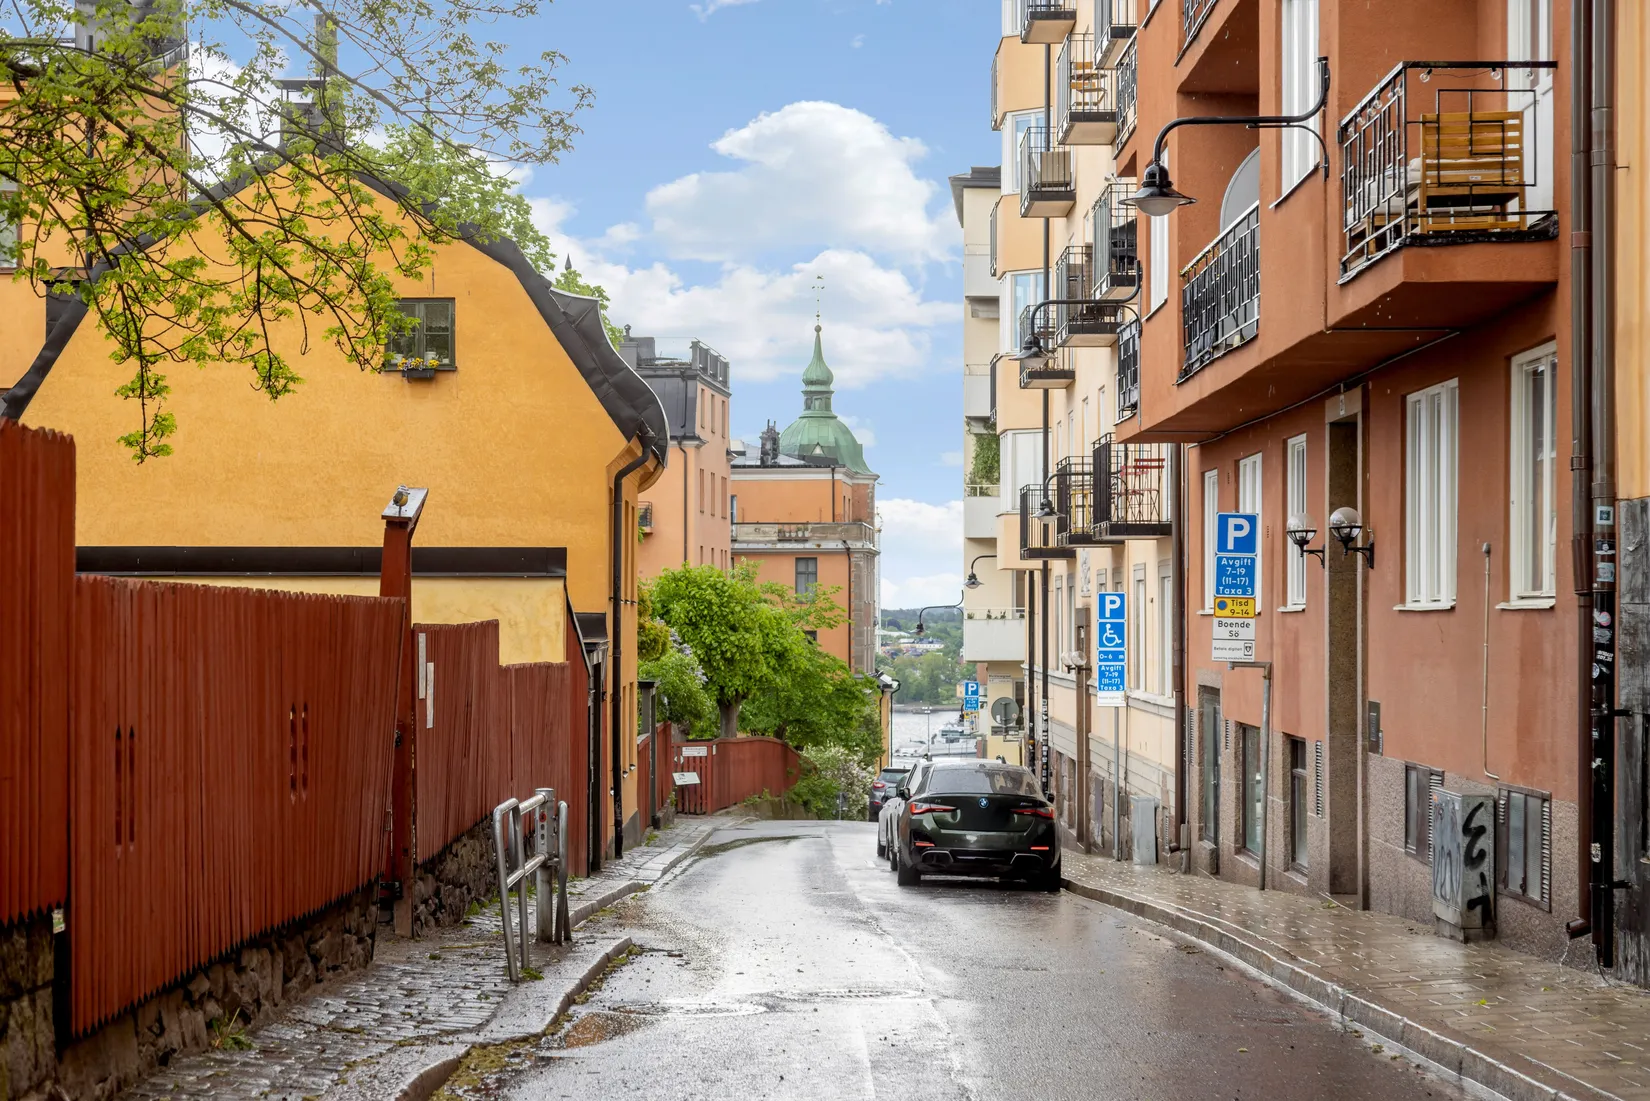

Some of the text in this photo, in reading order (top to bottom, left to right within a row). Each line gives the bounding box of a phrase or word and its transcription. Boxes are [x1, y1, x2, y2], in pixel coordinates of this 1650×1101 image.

[1227, 517, 1251, 550] P
[1221, 557, 1252, 567] Avgift
[1225, 567, 1246, 575] 7-19
[1221, 576, 1249, 586] (11-17)
[1218, 586, 1252, 595] Taxa 3
[1105, 595, 1121, 618] P
[1230, 599, 1249, 607] Tisd
[1229, 608, 1250, 616] 9-14
[1217, 620, 1251, 629] Boende
[1228, 630, 1240, 638] Sö
[968, 683, 977, 695] P
